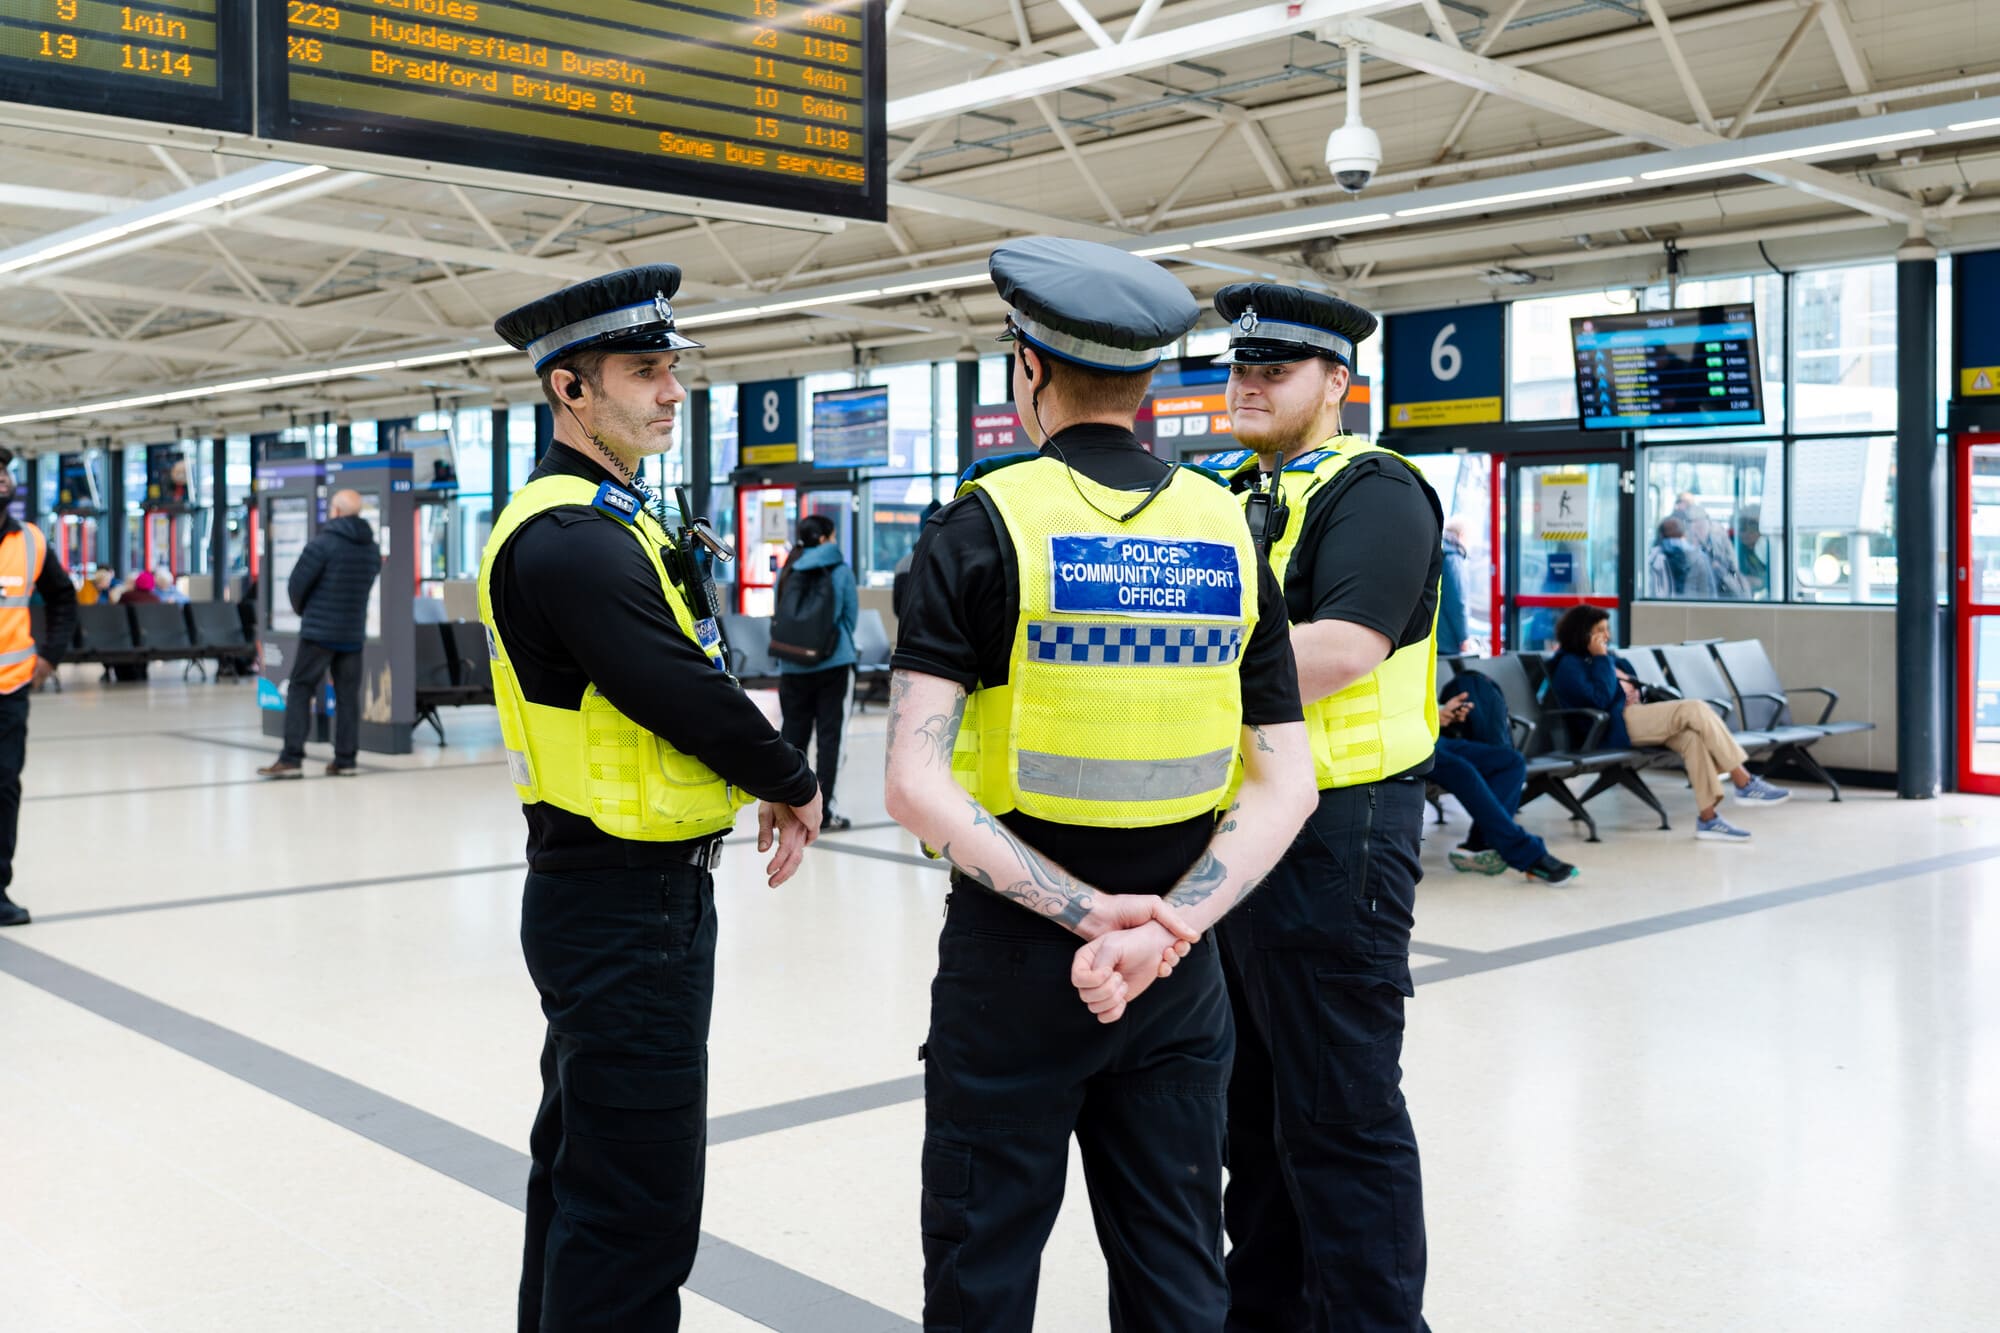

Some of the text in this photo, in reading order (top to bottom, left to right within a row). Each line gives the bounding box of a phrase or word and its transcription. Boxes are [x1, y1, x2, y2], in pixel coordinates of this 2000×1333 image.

[57, 0, 187, 39] 9 1min
[754, 0, 777, 18] 13
[39, 31, 192, 77] 19 11:14
[288, 1, 848, 120] 229 Huddersfield BusStn 10 6min
[752, 28, 849, 62] 23 11:15
[288, 36, 849, 149] X6 Bradford Bridge St 15 11:18
[754, 57, 776, 78] 11
[802, 67, 847, 91] 4min
[659, 132, 865, 183] Some bus services
[1431, 323, 1462, 381] 6
[763, 390, 780, 432] 8
[1121, 544, 1180, 564] POLICE
[1062, 563, 1234, 588] COMMUNITY SUPPORT
[1118, 586, 1187, 607] OFFICER
